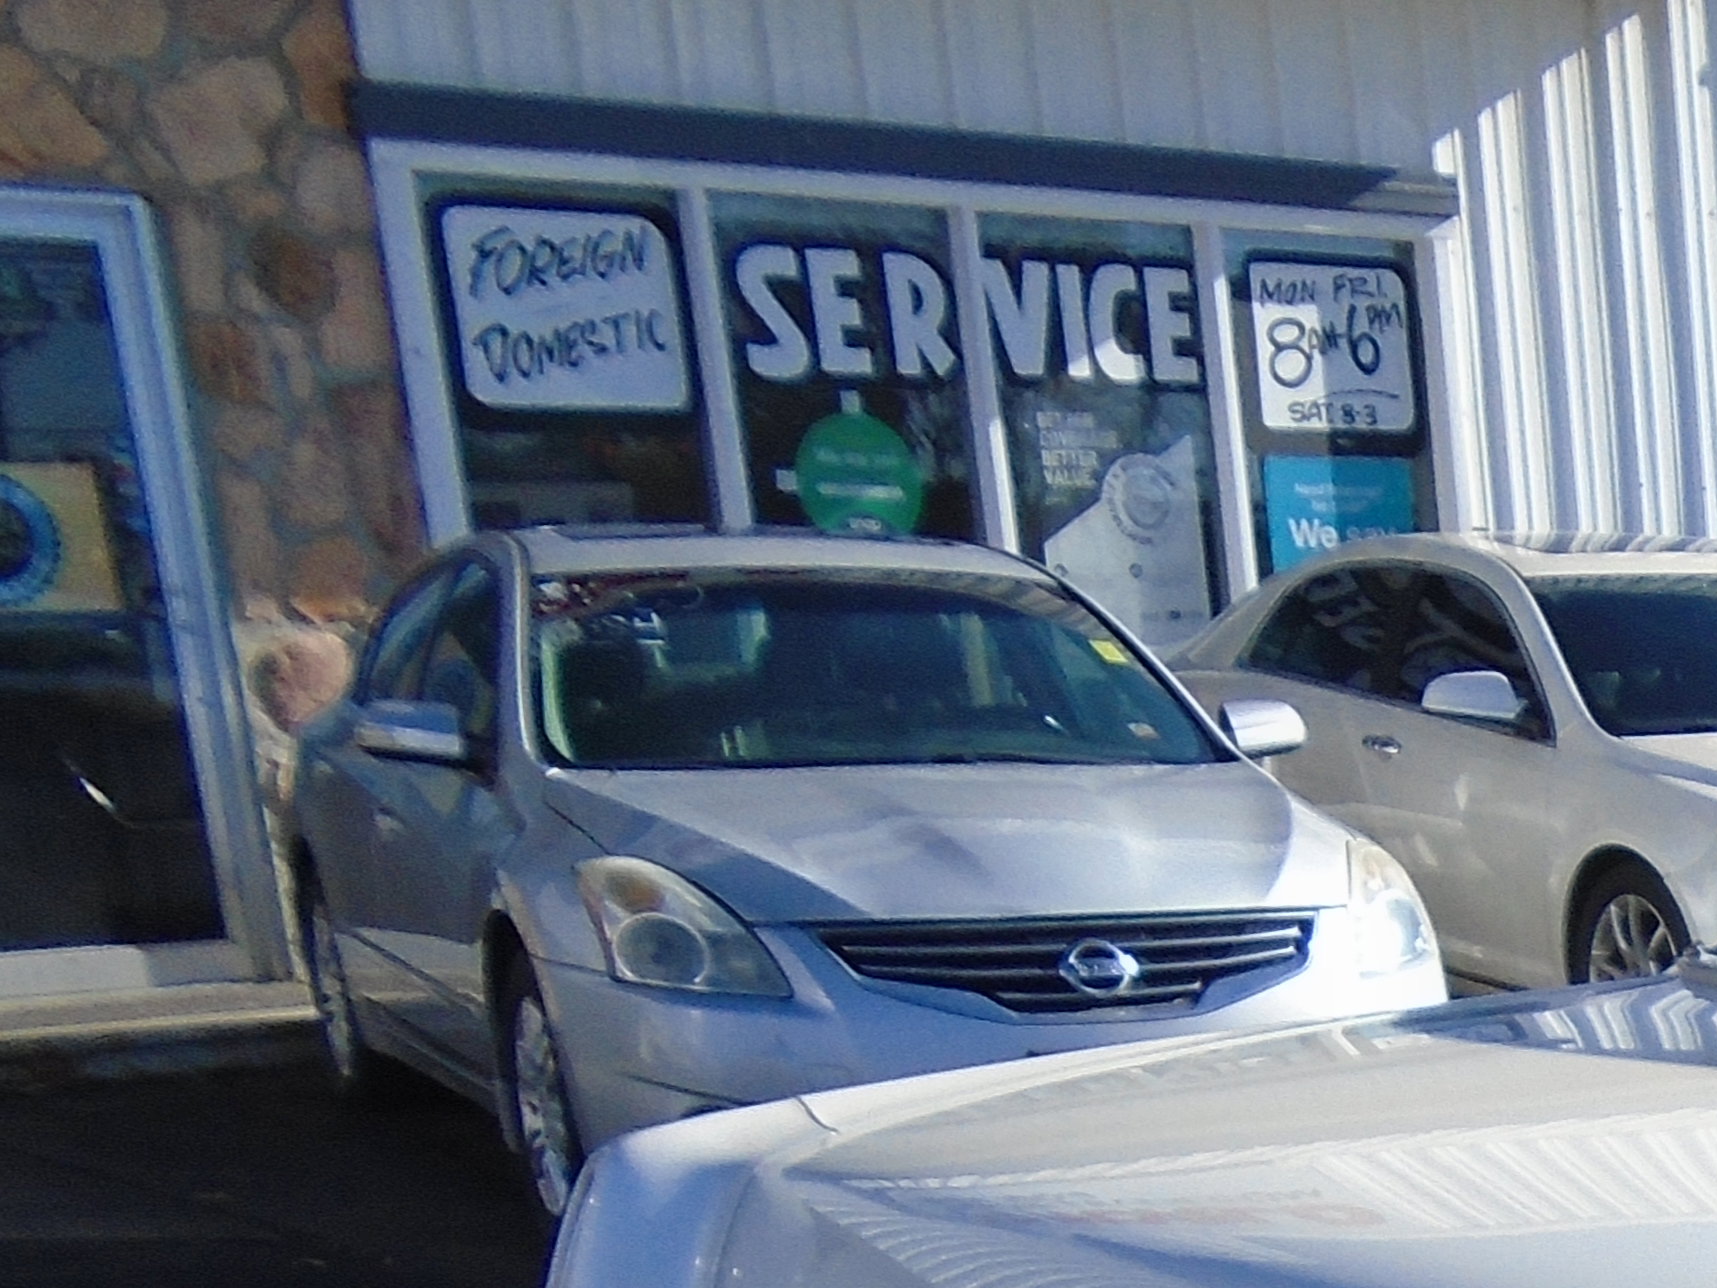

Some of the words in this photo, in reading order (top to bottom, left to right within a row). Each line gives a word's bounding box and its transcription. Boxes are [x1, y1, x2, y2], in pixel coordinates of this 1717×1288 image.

[469, 224, 648, 298] FOREIGN
[1259, 278, 1316, 307] MON
[471, 308, 666, 383] DOMESTIC
[735, 243, 1200, 382] SERVICE
[1287, 517, 1338, 549] We
